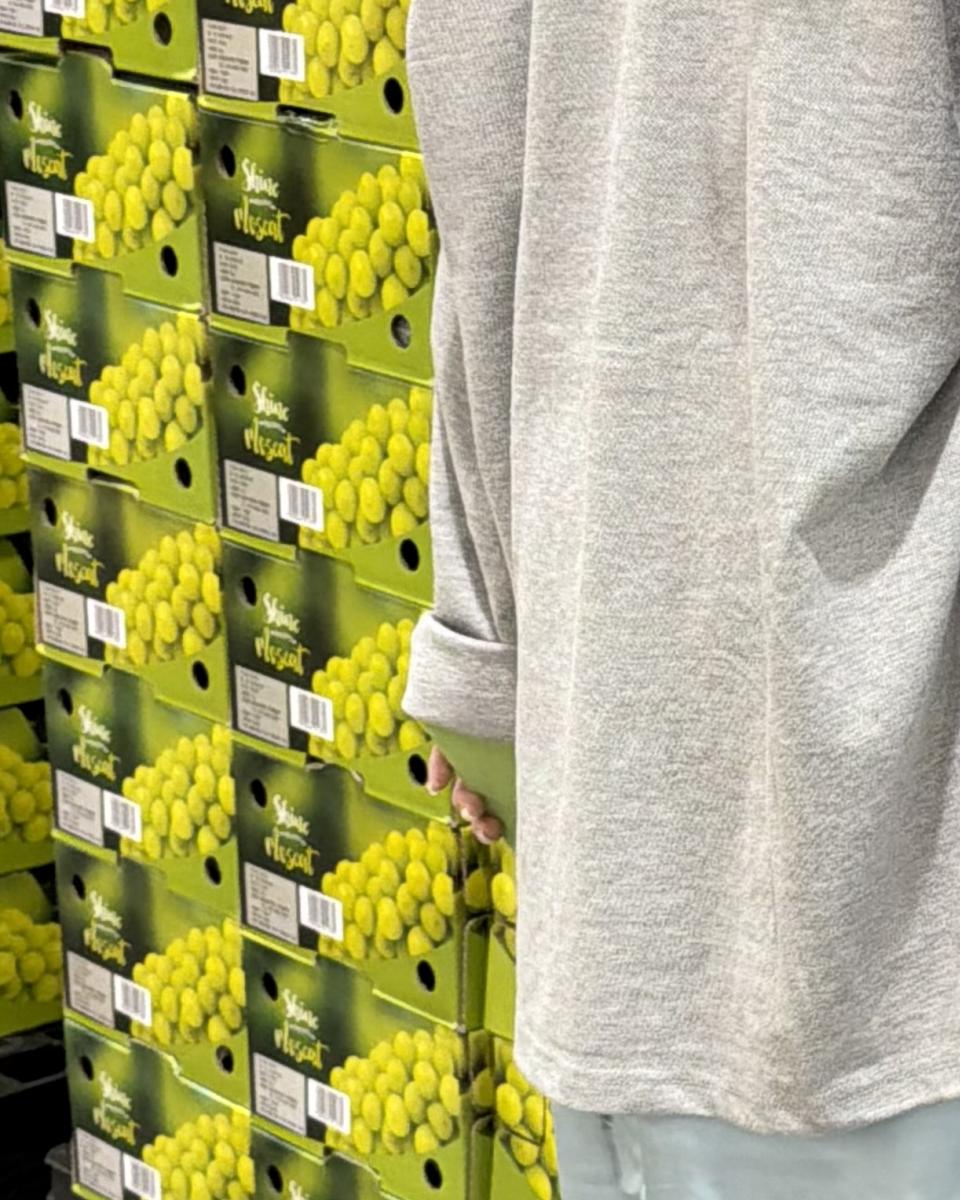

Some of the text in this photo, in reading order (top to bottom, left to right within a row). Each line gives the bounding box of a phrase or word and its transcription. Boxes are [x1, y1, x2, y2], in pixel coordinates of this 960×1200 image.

[241, 158, 279, 199] Shine
[251, 381, 290, 421] Shine
[262, 593, 300, 634] Shine
[272, 795, 309, 837] Shine
